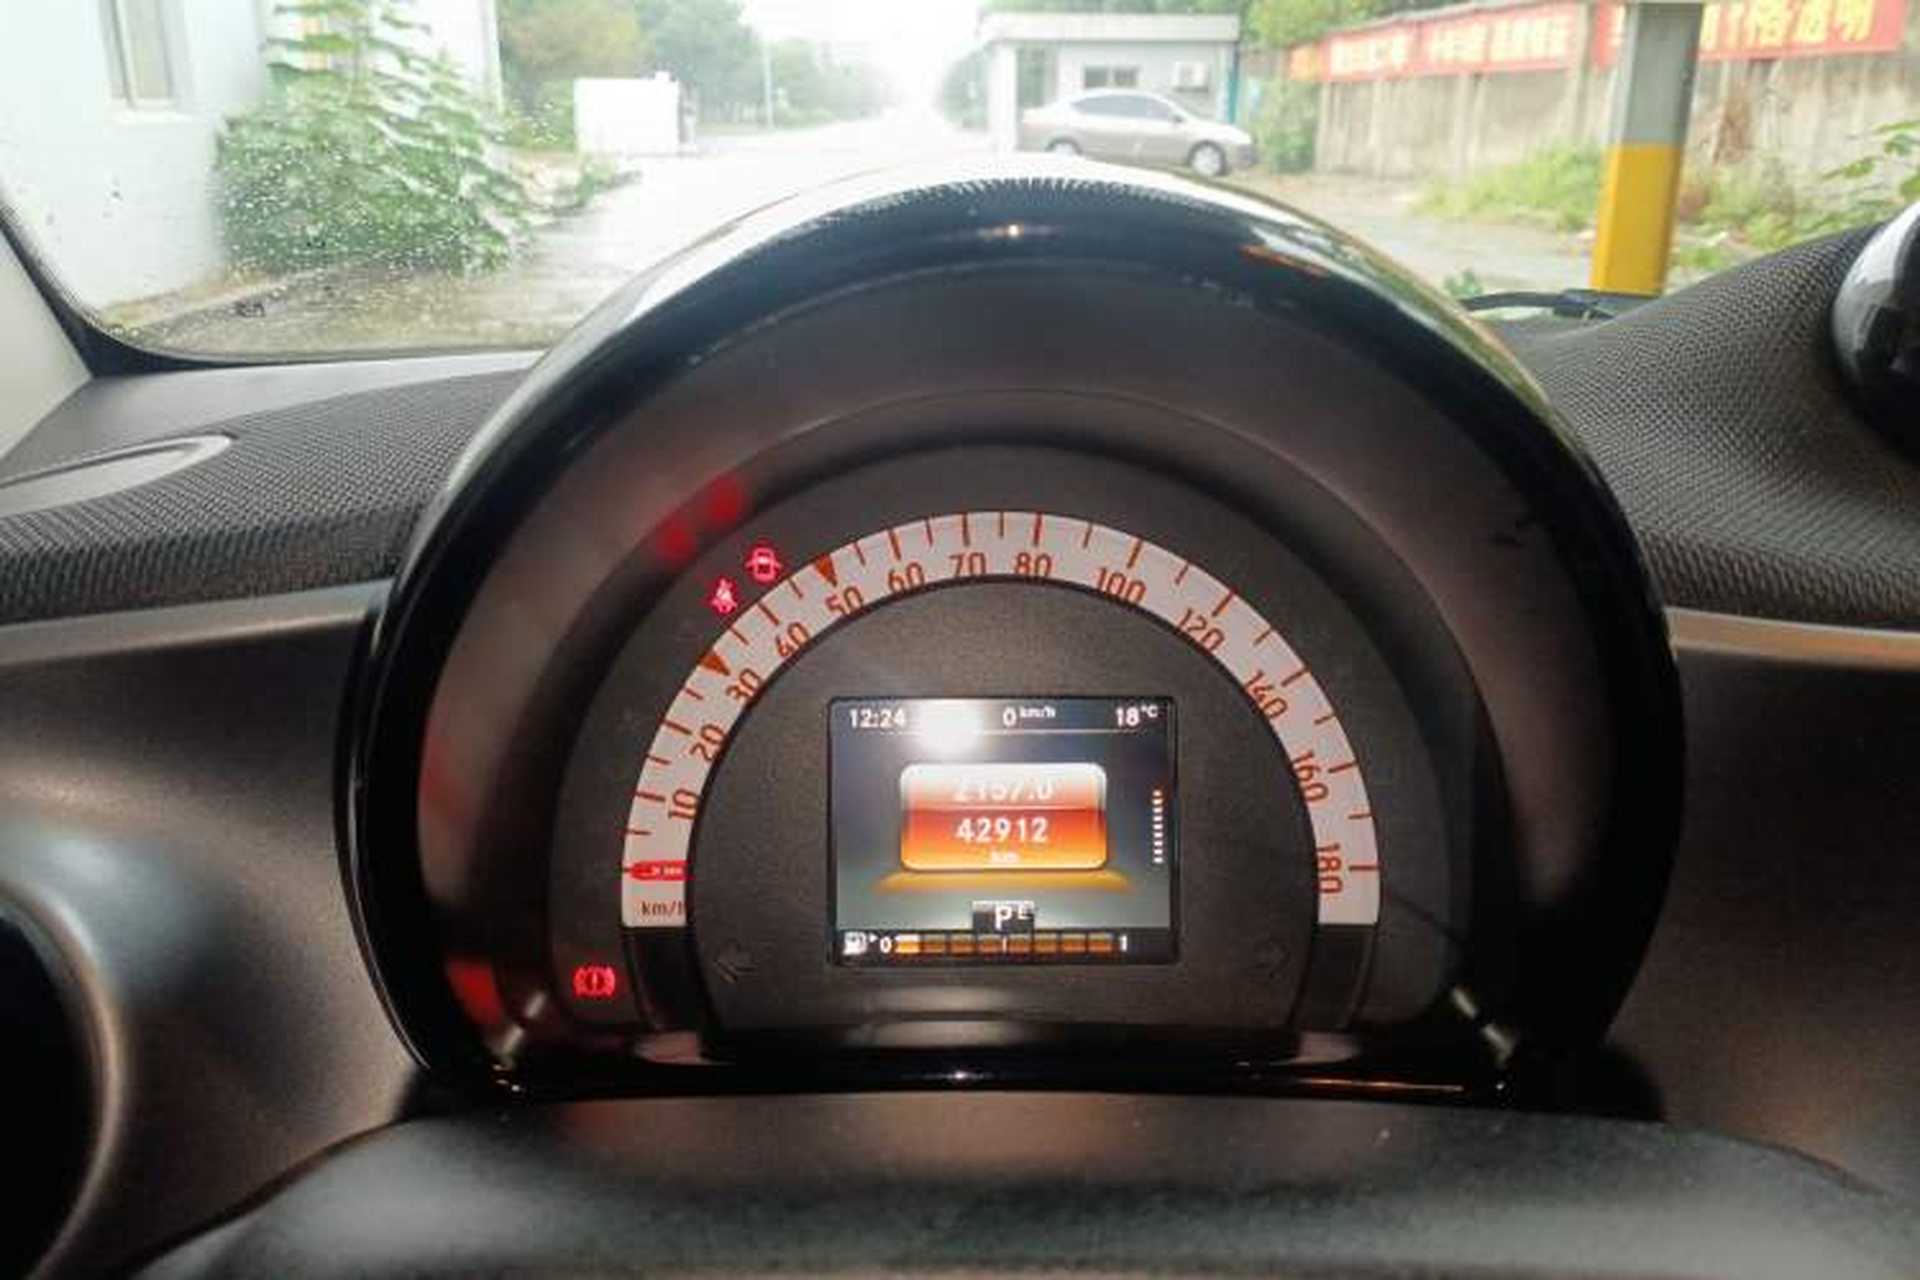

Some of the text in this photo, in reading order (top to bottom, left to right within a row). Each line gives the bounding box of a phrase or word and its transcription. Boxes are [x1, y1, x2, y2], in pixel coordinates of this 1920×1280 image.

[888, 562, 926, 593] 60
[948, 552, 987, 577] 70
[1013, 552, 1053, 578] 80
[1097, 567, 1147, 603] 100
[827, 586, 865, 617] 50
[774, 621, 810, 658] 40
[1177, 607, 1227, 652] 120
[726, 668, 762, 701] 30
[1244, 669, 1290, 721] 140
[849, 708, 906, 729] 12:24
[690, 723, 727, 762] 20
[1292, 750, 1329, 803] 160
[668, 788, 699, 820] 10
[955, 816, 1049, 844] 42912
[1316, 842, 1343, 895] 180
[878, 936, 892, 954] 0
